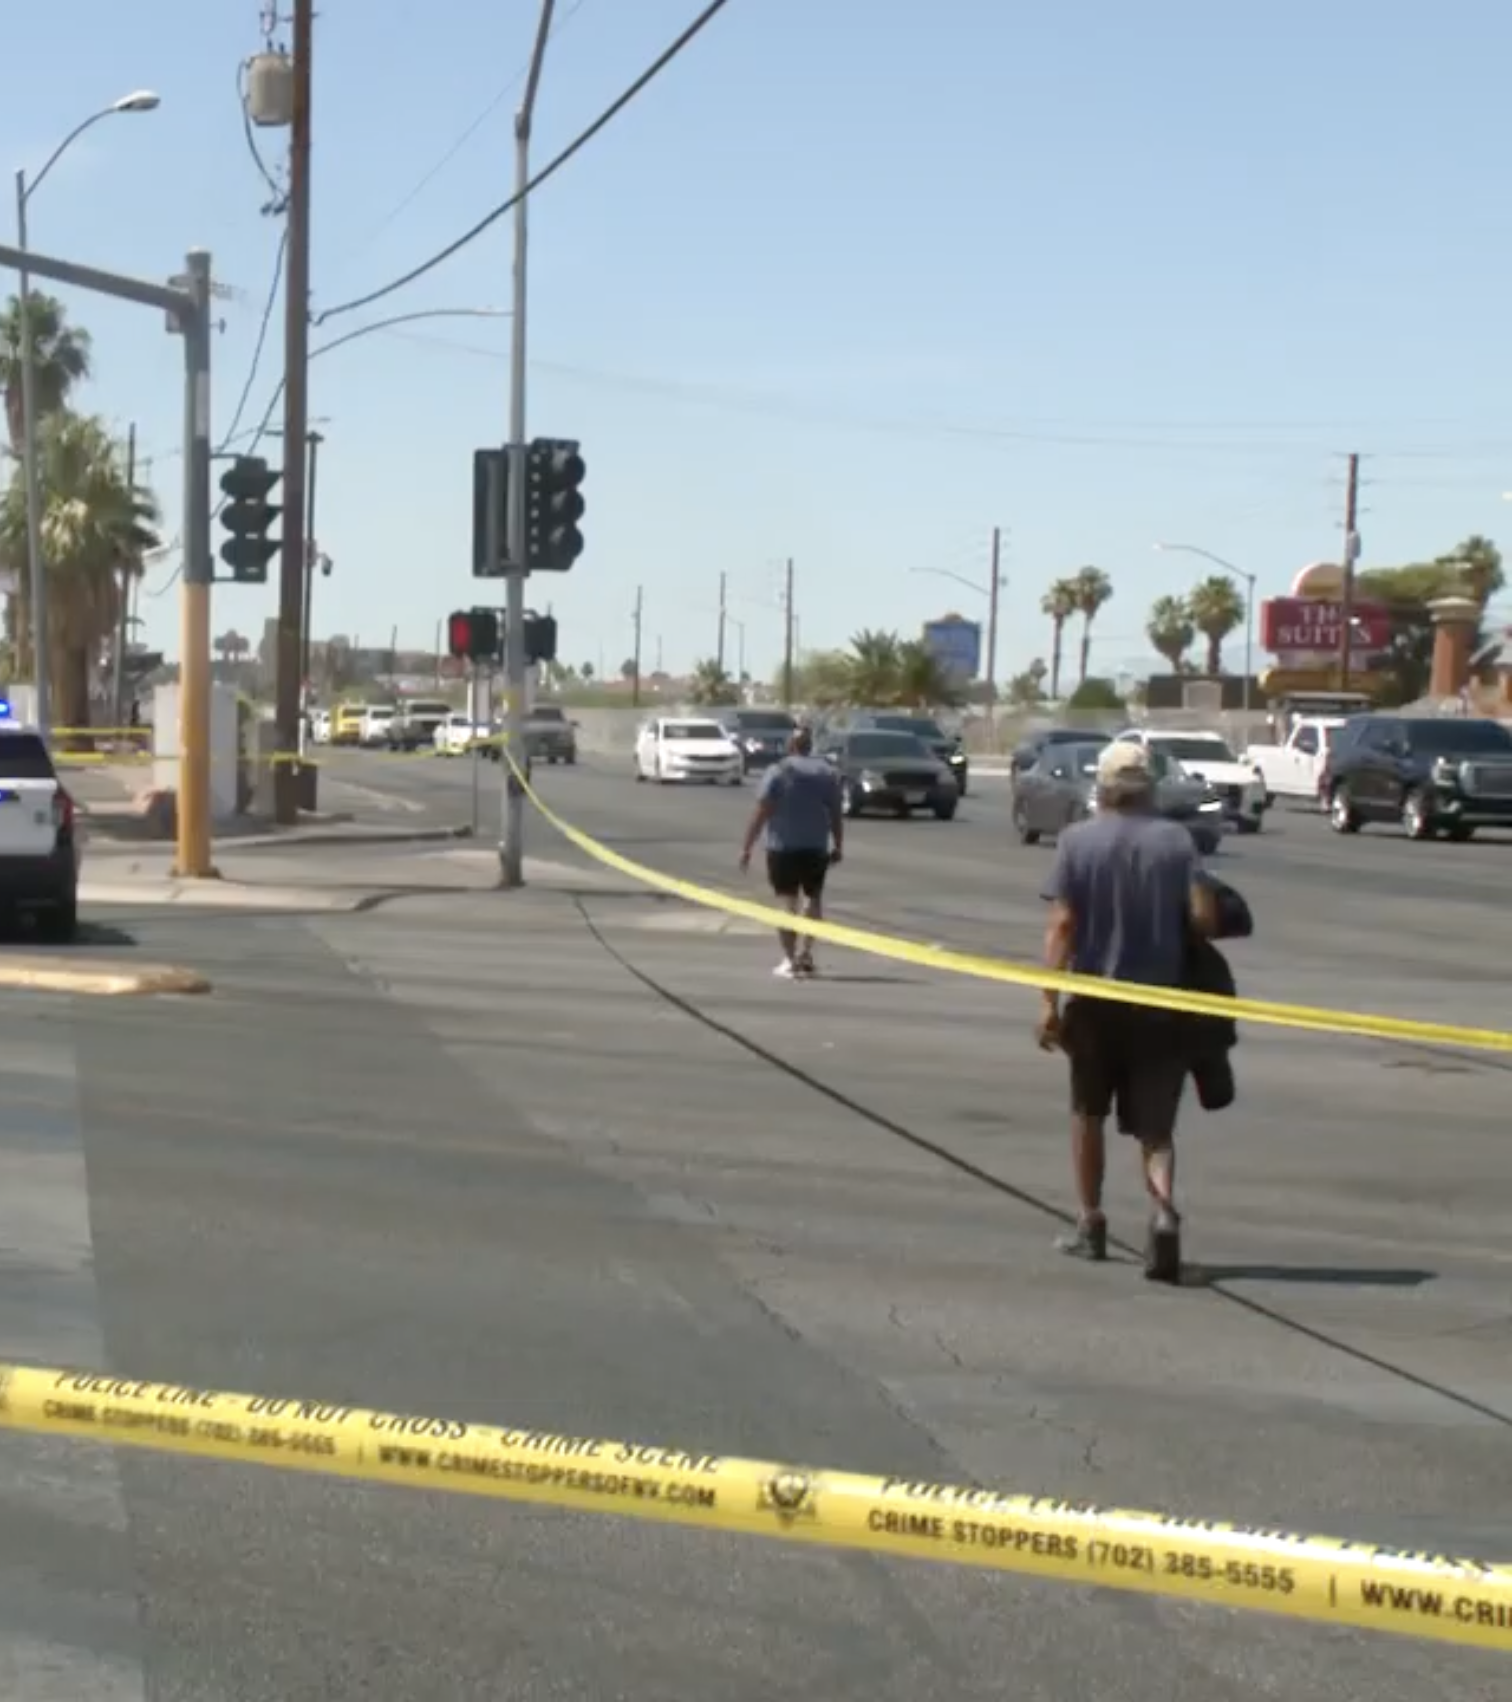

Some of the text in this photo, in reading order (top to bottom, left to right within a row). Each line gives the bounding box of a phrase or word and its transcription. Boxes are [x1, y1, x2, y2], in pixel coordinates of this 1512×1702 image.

[1299, 604, 1344, 626] TH
[1276, 624, 1373, 645] SUITS
[867, 1509, 944, 1539] CRIME
[952, 1519, 1079, 1560] STOPPERS
[1088, 1538, 1154, 1576] (702)
[1163, 1550, 1295, 1595] 385-5555
[1359, 1577, 1512, 1628] WWW.CRI
